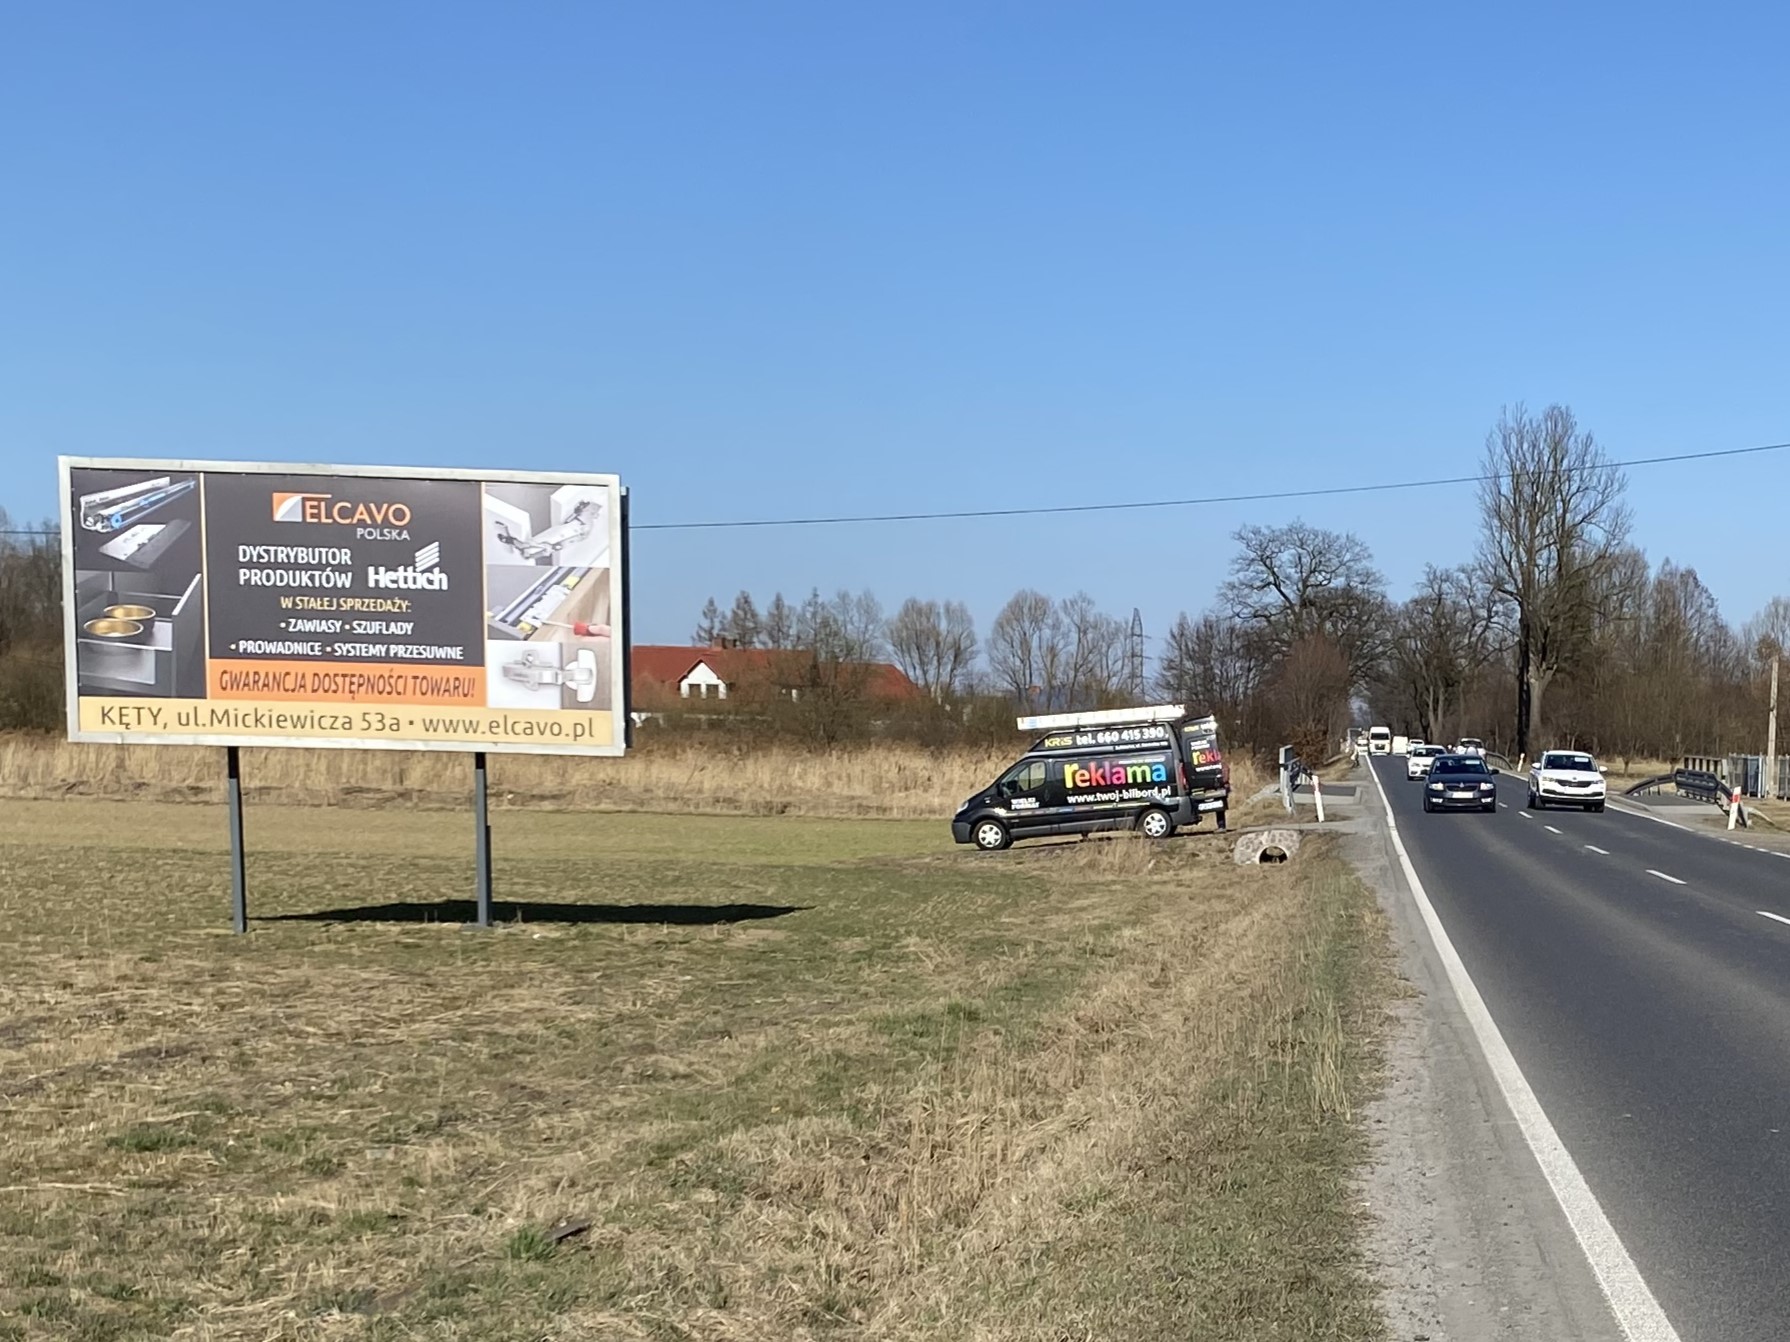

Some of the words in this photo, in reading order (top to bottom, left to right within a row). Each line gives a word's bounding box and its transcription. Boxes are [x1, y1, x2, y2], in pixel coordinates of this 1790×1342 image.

[304, 501, 411, 526] ELCAVO
[356, 527, 411, 541] POLSKA
[238, 545, 352, 565] DYSTRYBUTOR
[238, 567, 352, 588] PRODUKTÓW
[367, 564, 448, 590] Hettich
[280, 596, 295, 609] W
[296, 597, 337, 611] STAŁEJ
[339, 597, 411, 613] SPRZEDAŻY:
[287, 618, 343, 633] ZAWIASY
[352, 620, 414, 635] SZUFLADY
[239, 640, 322, 656] PROWADNICE
[334, 642, 388, 658] SYSTEMY
[389, 644, 464, 660] PRZESUWNE
[219, 669, 306, 693] GWARANCJA
[311, 668, 407, 700] DOSTĘPNOŚCI
[411, 675, 476, 698] TOWARU!
[100, 705, 168, 730] KĘTY,
[360, 712, 400, 732] 53a
[422, 714, 594, 741] www.elcavo.pl
[1076, 733, 1095, 745] tel.
[1097, 731, 1119, 744] 660
[1121, 728, 1144, 741] 415
[1063, 761, 1167, 789] reklama
